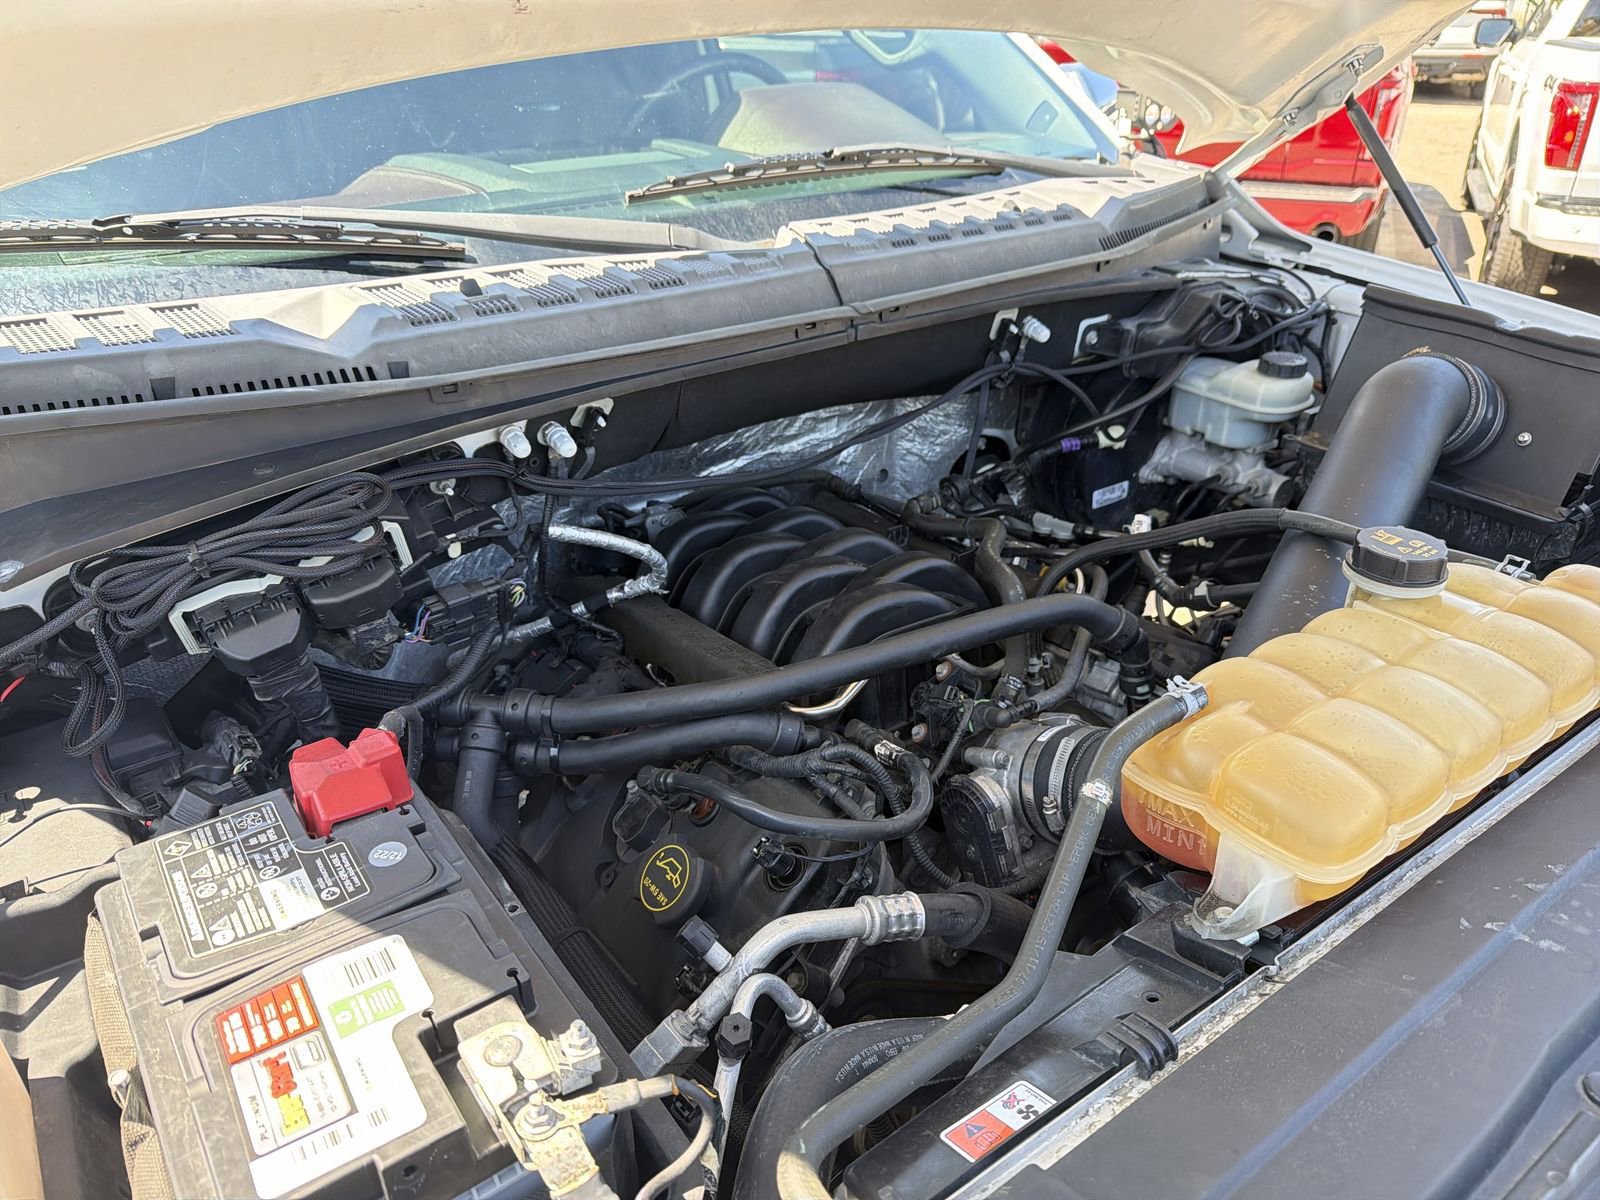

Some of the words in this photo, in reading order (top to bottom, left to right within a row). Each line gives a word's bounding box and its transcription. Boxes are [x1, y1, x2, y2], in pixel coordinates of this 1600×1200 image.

[1146, 794, 1197, 828] MAX
[1145, 815, 1194, 851] MIN
[329, 853, 355, 893] NON-SPILLABLE
[643, 876, 659, 896] 5W-20
[656, 892, 668, 906] SAE
